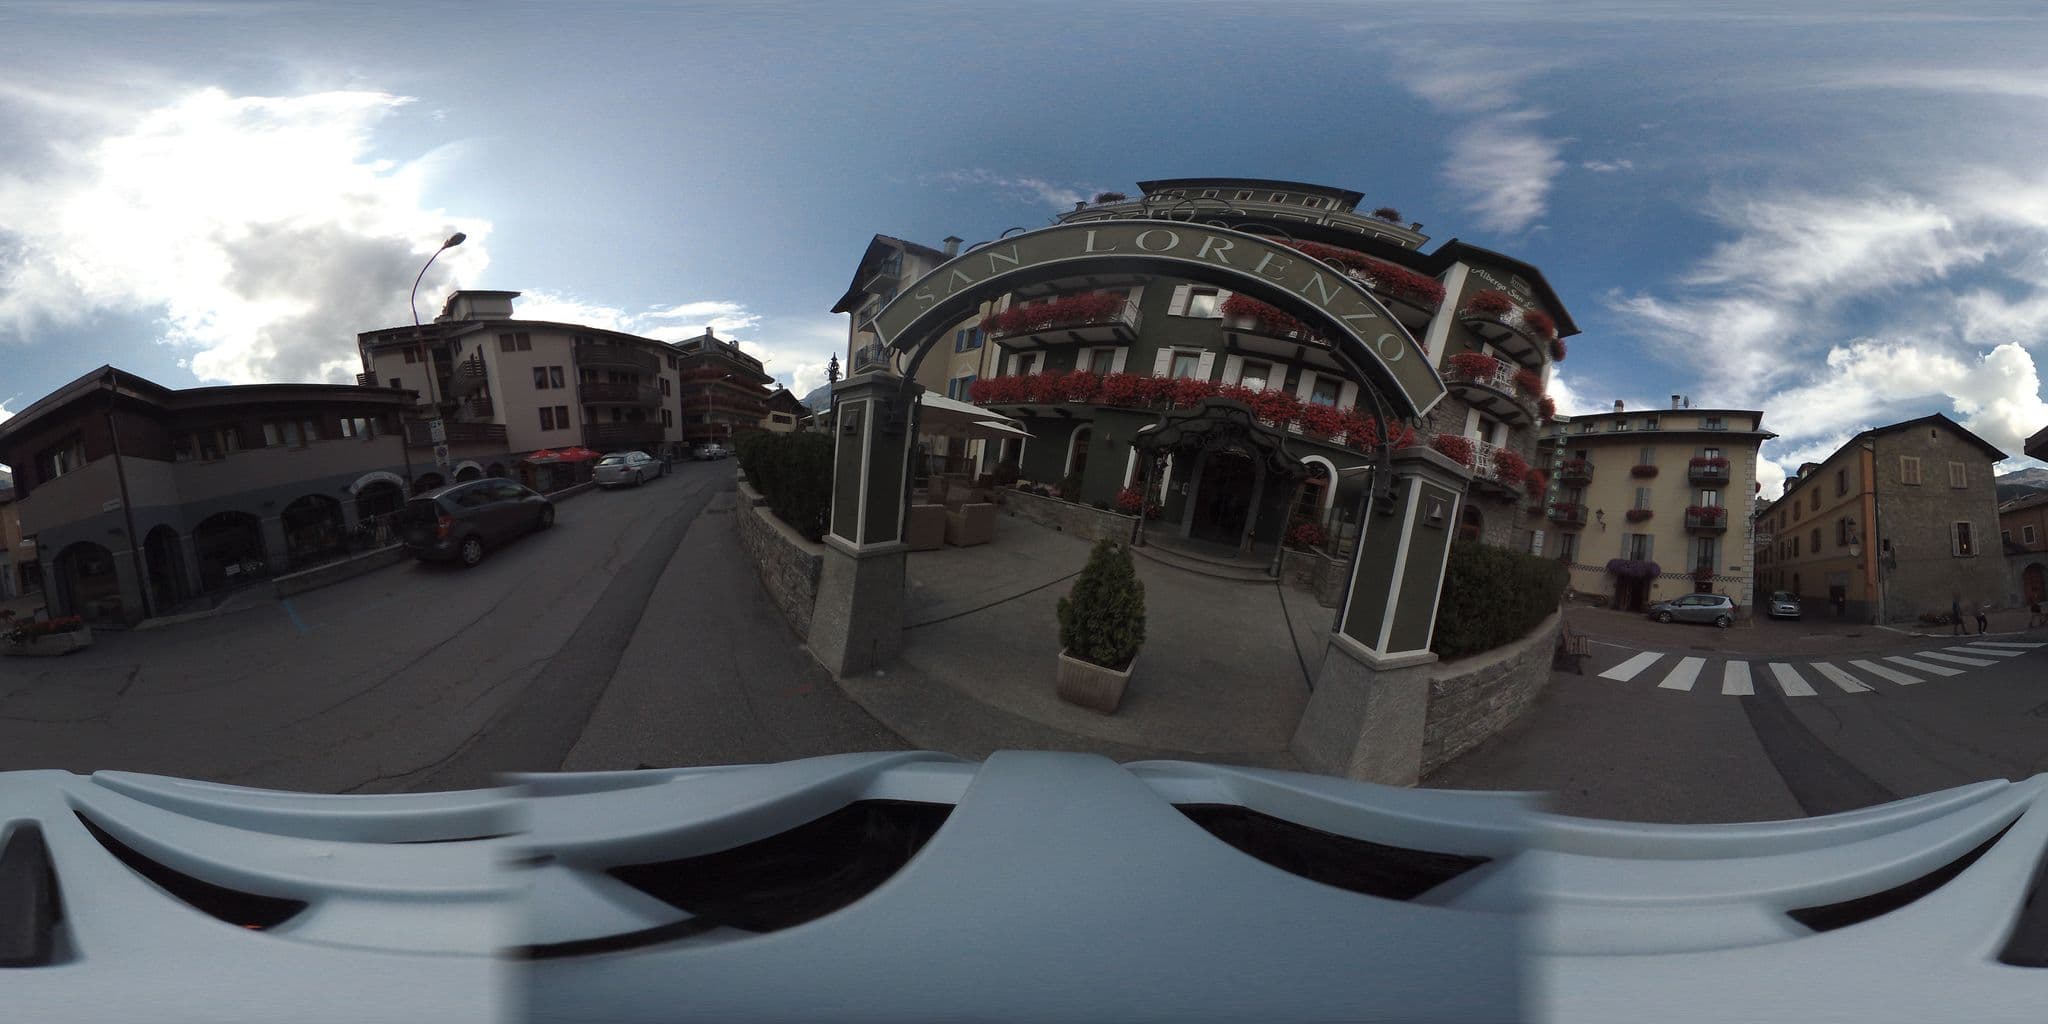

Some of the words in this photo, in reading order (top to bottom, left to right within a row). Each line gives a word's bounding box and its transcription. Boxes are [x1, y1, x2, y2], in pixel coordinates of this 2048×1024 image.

[915, 244, 1019, 312] SAN
[1083, 229, 1405, 361] LORENZO
[1470, 268, 1506, 291] Albergo
[1507, 288, 1524, 303] San
